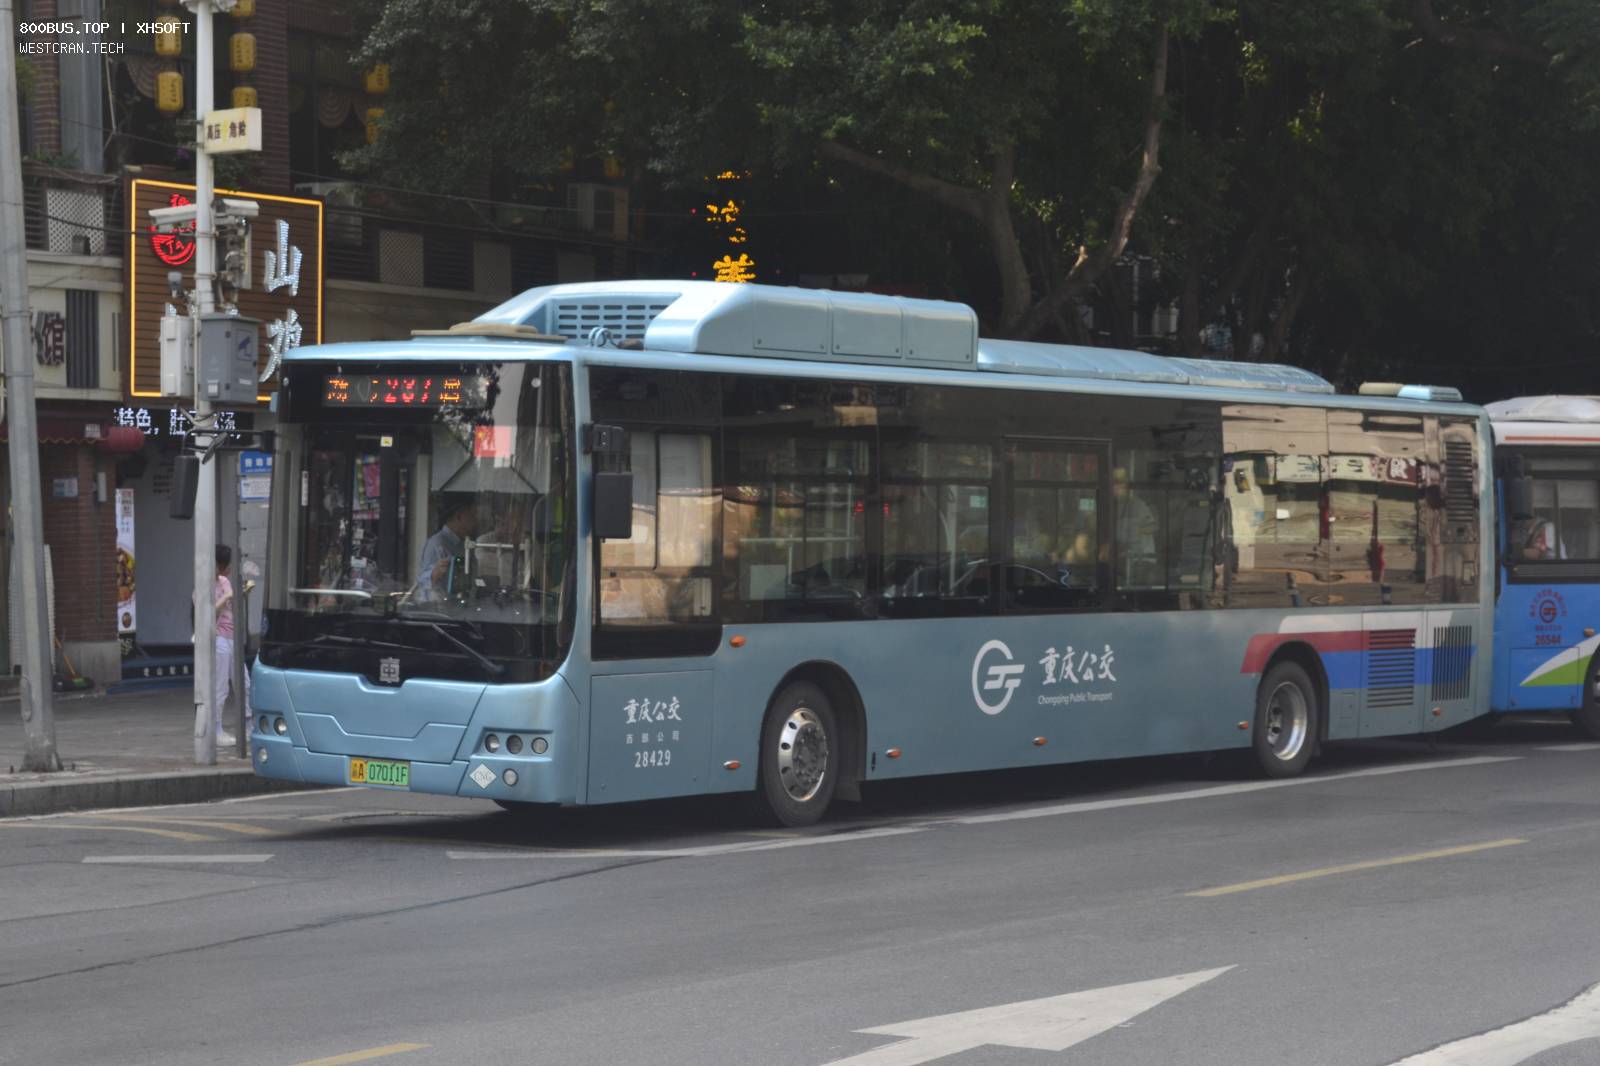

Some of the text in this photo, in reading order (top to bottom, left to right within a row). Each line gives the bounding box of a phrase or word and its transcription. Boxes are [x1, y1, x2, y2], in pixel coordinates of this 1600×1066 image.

[1039, 644, 1117, 686] 重庆公交
[623, 696, 682, 724] 重庆公交
[634, 749, 671, 768] 28429
